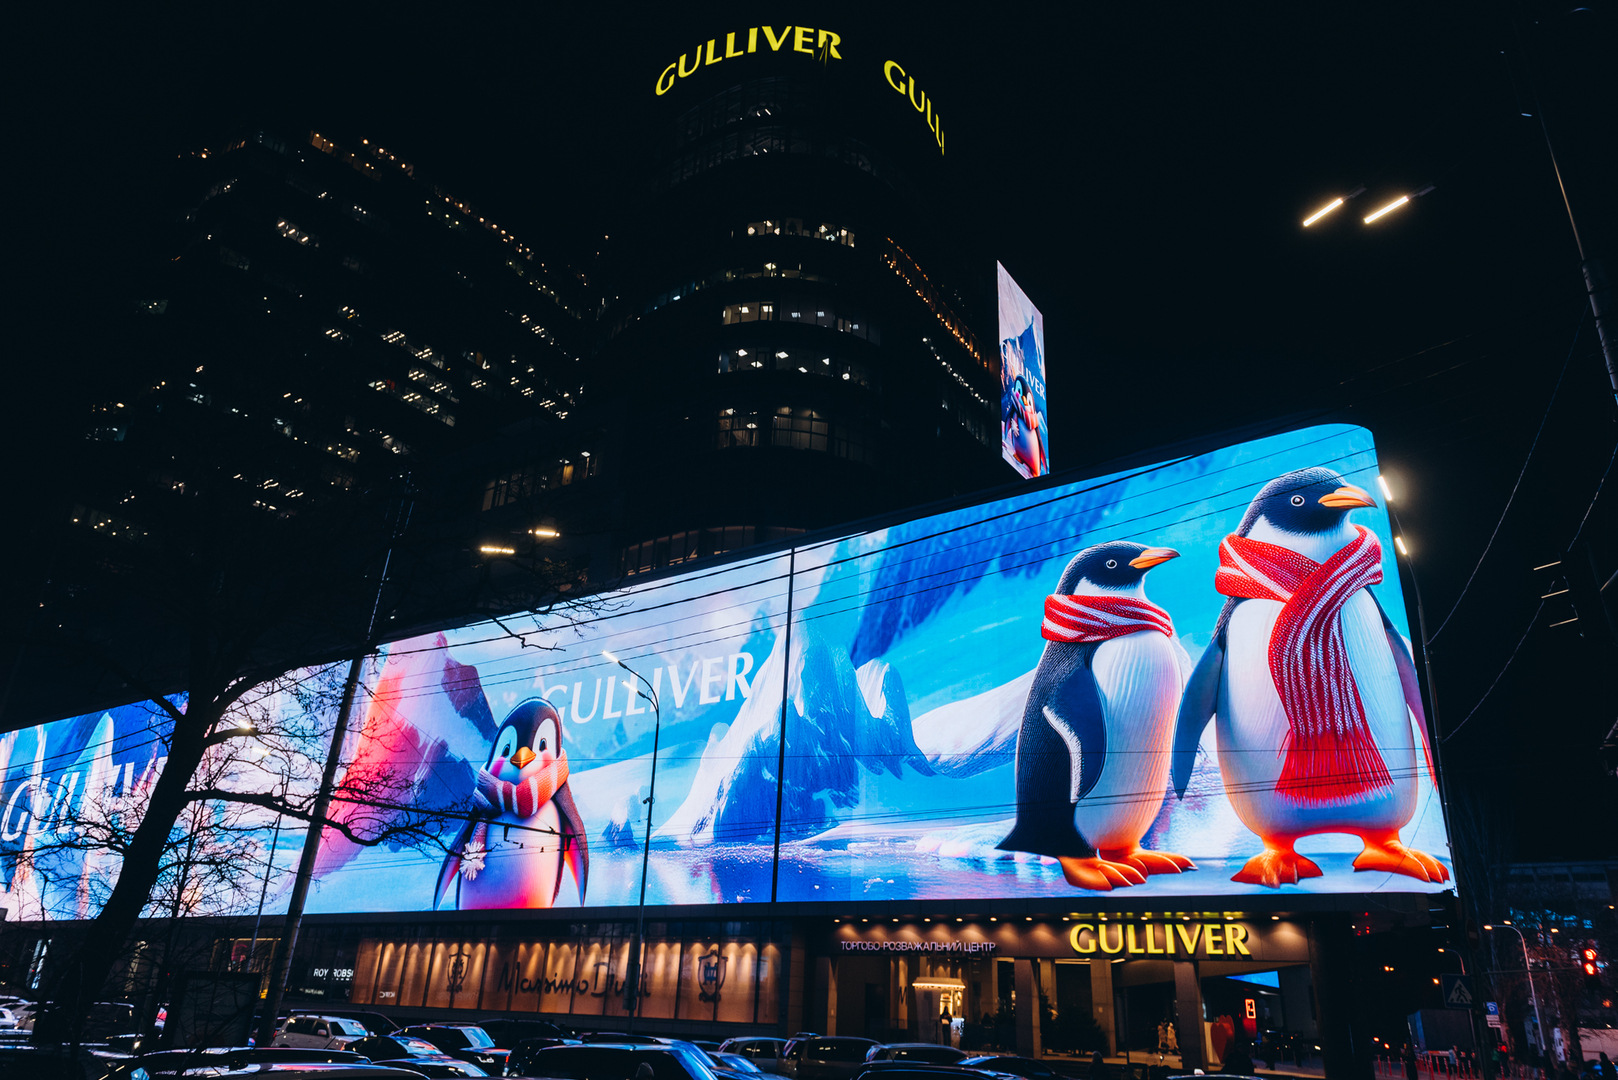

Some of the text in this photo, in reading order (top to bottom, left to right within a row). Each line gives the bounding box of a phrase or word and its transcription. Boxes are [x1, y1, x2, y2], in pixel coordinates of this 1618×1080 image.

[656, 25, 842, 96] GULLIVER
[963, 941, 996, 954] ЦЕНТР
[1069, 923, 1250, 955] GULLIVER
[313, 968, 329, 977] ROY
[497, 961, 651, 998] Massimo Dui
